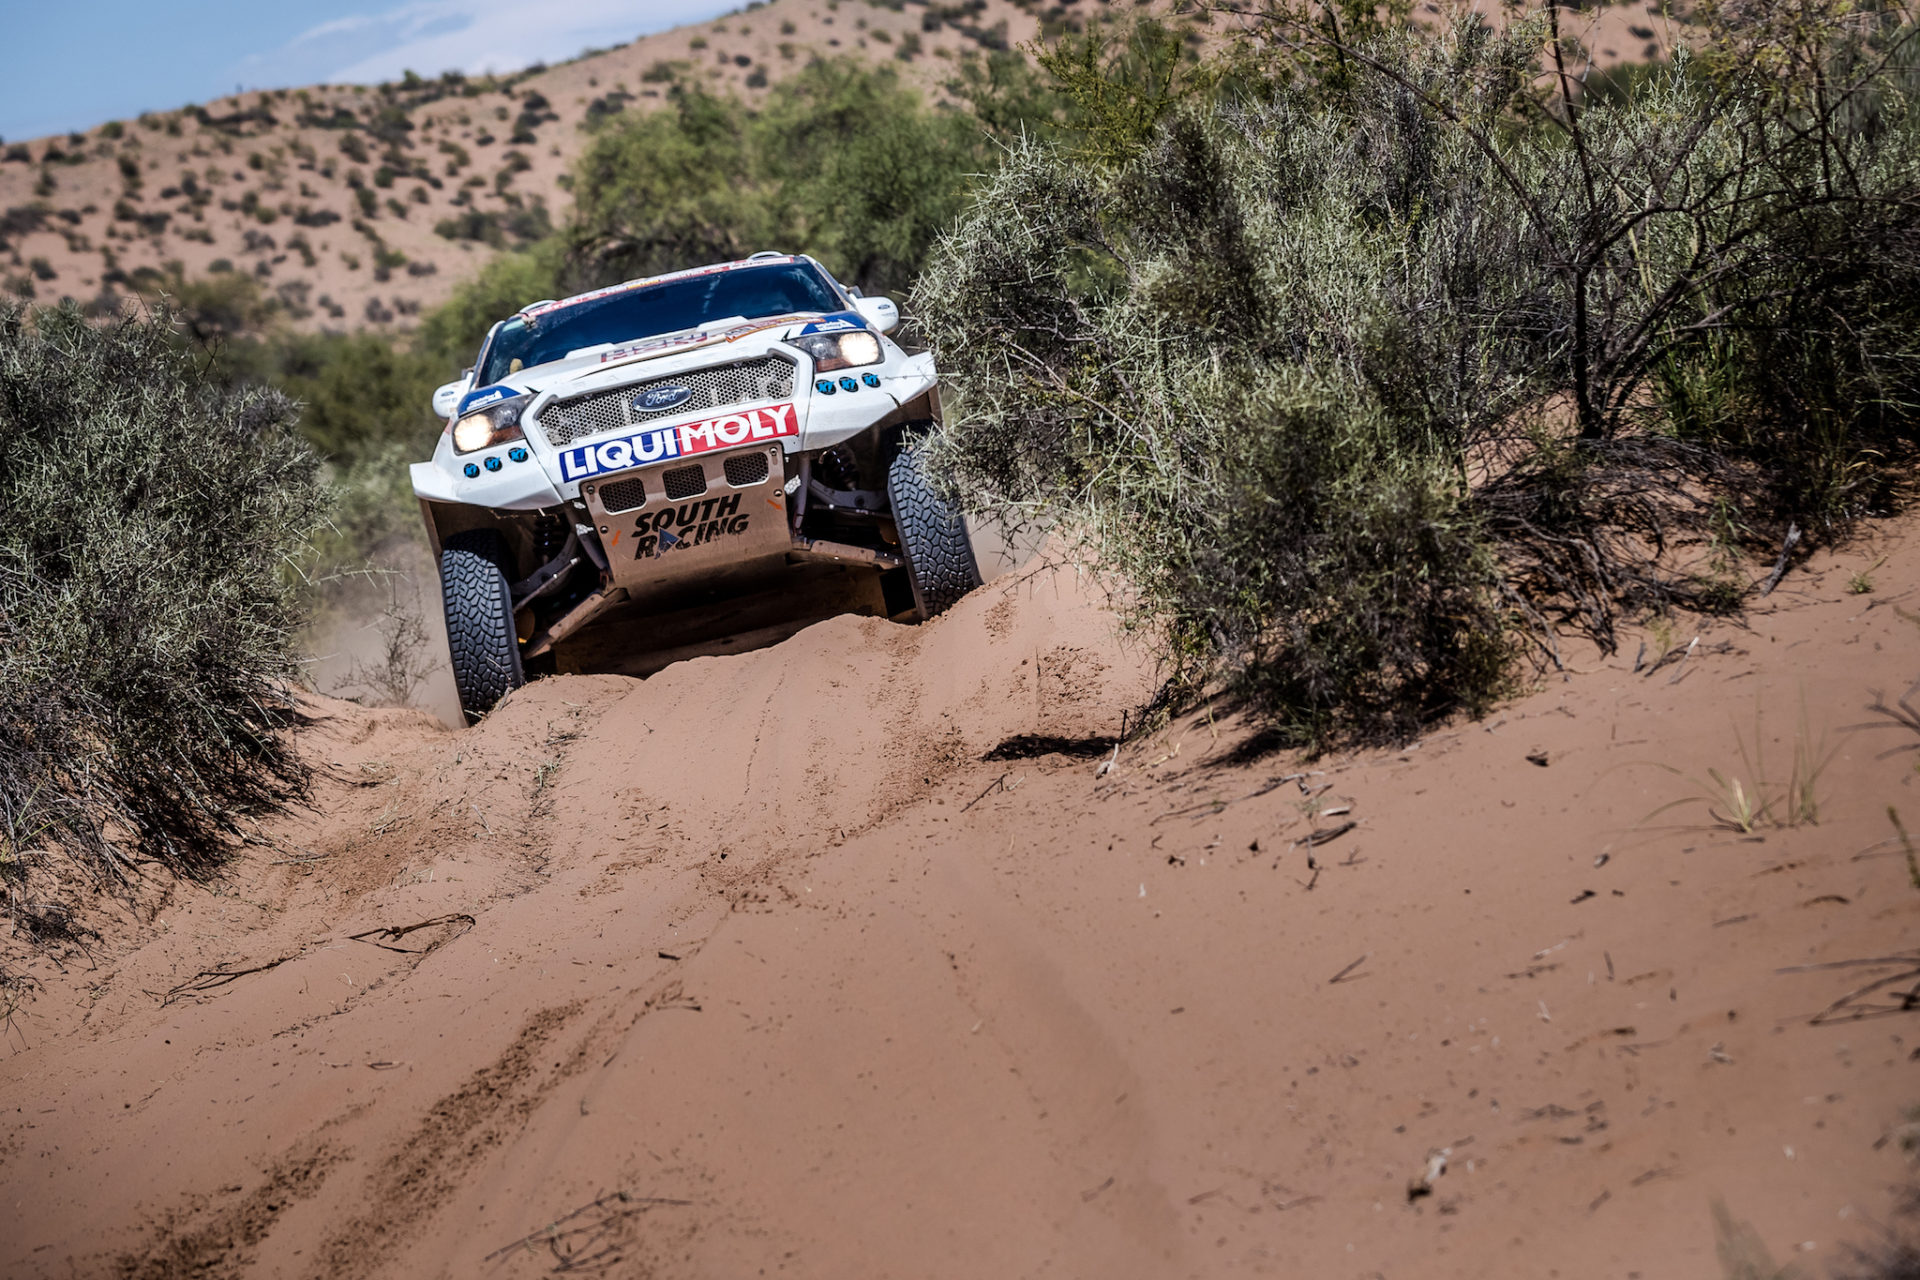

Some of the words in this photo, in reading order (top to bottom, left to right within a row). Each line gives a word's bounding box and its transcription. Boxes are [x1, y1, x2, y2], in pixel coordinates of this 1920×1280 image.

[564, 429, 674, 481] LIQUI
[679, 405, 792, 453] MOLY
[631, 493, 742, 538] SOUTH
[634, 513, 750, 560] RACING
